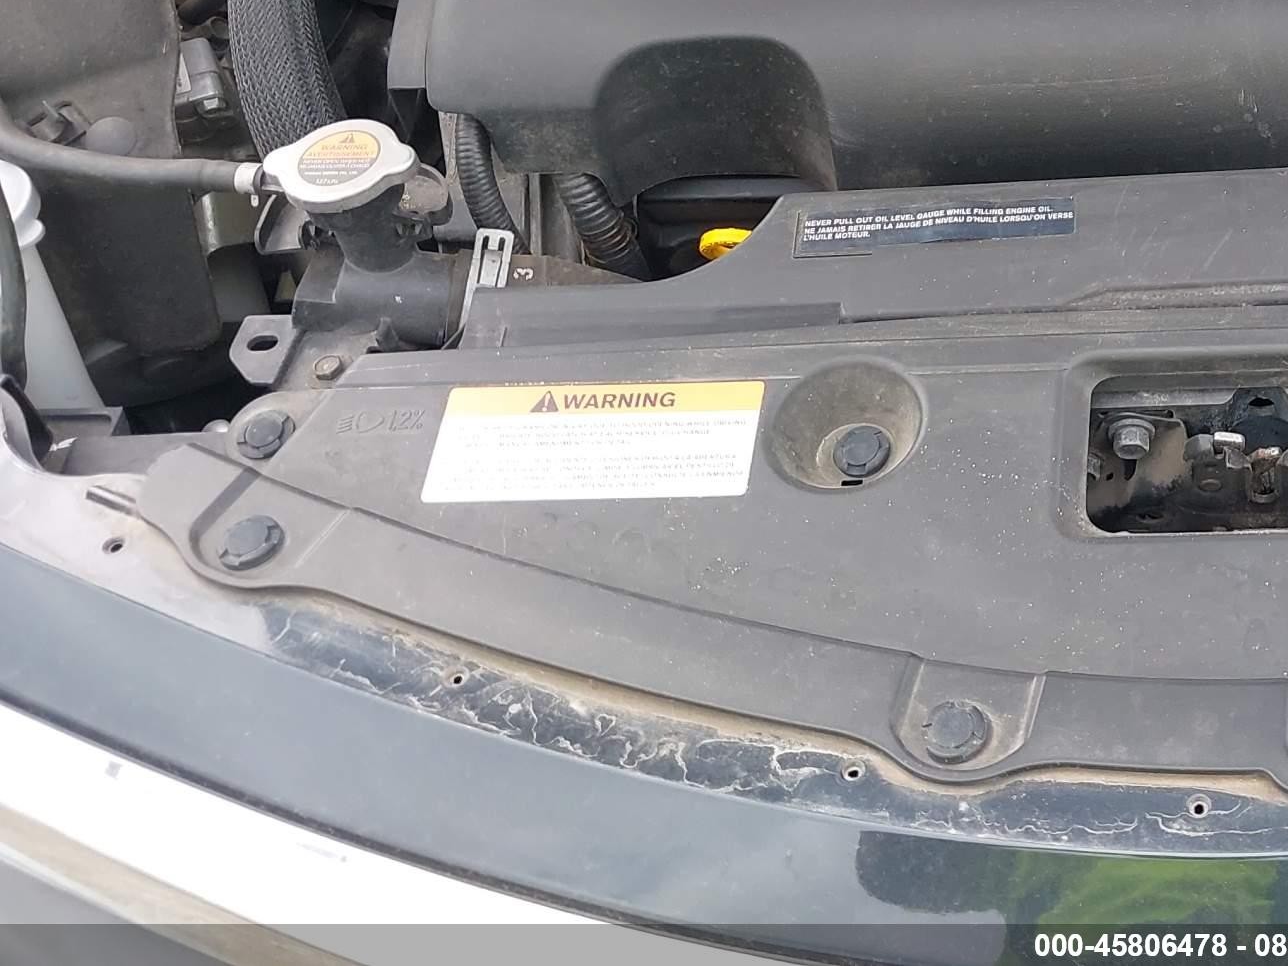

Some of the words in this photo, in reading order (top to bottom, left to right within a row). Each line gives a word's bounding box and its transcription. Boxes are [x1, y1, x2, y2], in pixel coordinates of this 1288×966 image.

[805, 219, 832, 227] NEVER
[856, 216, 873, 224] OUT
[916, 210, 945, 219] GAUGE
[946, 208, 971, 216] WHILE
[973, 207, 1004, 215] FILLING
[1005, 206, 1037, 214] ENGINE
[817, 226, 846, 234] JAMAIS
[847, 224, 881, 232] RETIRER
[895, 221, 921, 229] JAUGE
[935, 216, 966, 225] NIVEAU
[966, 215, 998, 223] D'HUILE
[999, 214, 1046, 222] LORSQU'ON
[1048, 211, 1074, 220] VERSE
[834, 232, 870, 240] MOTEUR.
[562, 391, 677, 411] WARNING
